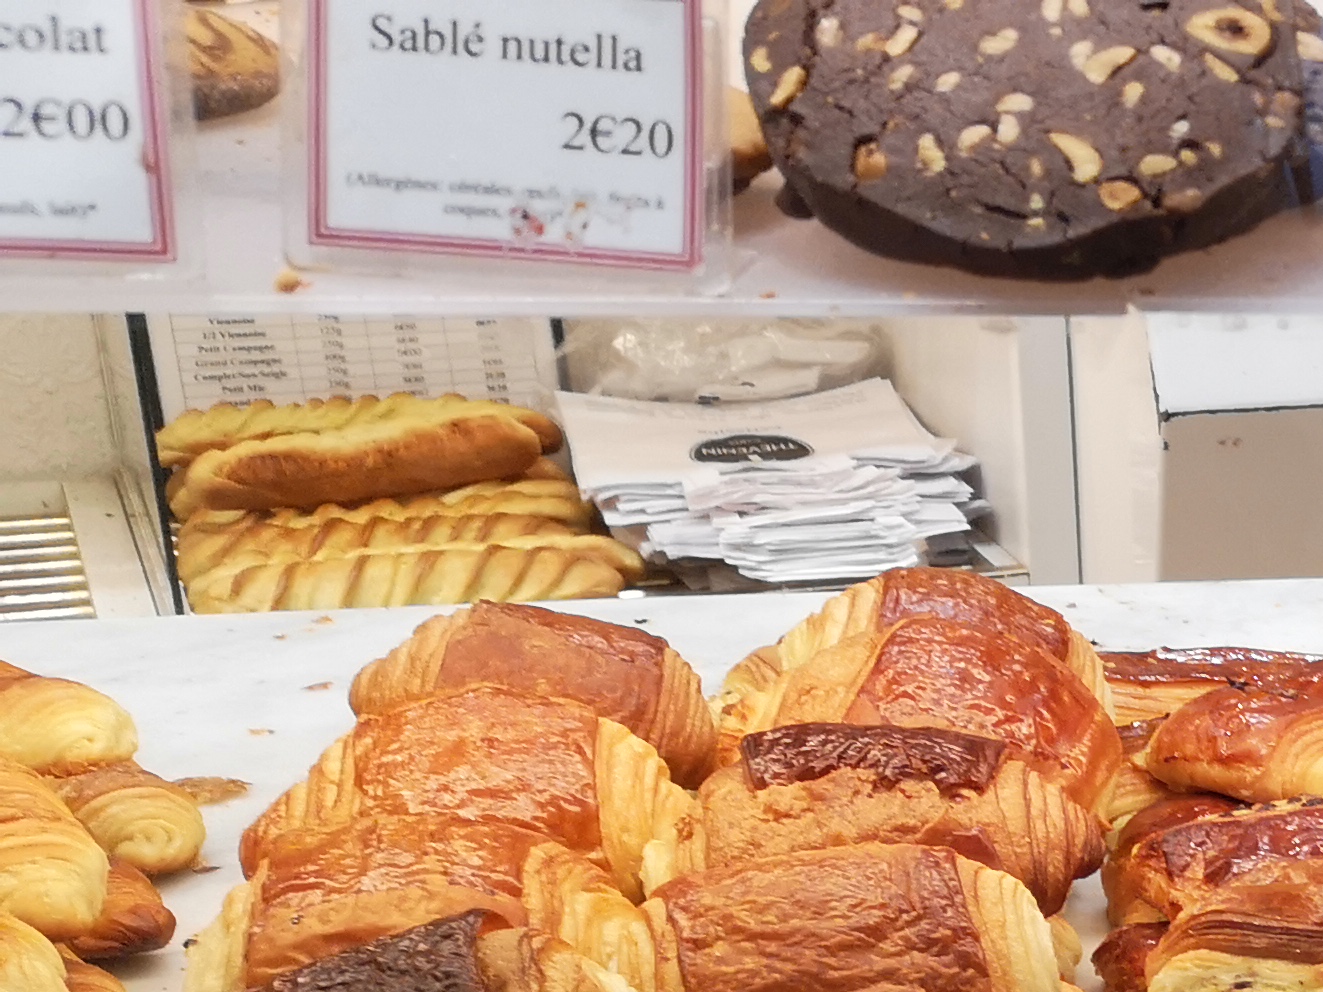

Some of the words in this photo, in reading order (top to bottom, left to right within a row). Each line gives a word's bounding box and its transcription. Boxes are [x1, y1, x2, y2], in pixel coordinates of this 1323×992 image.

[370, 13, 485, 58] Sablé
[500, 33, 644, 72] nutella
[0, 97, 129, 141] 2€00
[561, 111, 674, 158] 2€20
